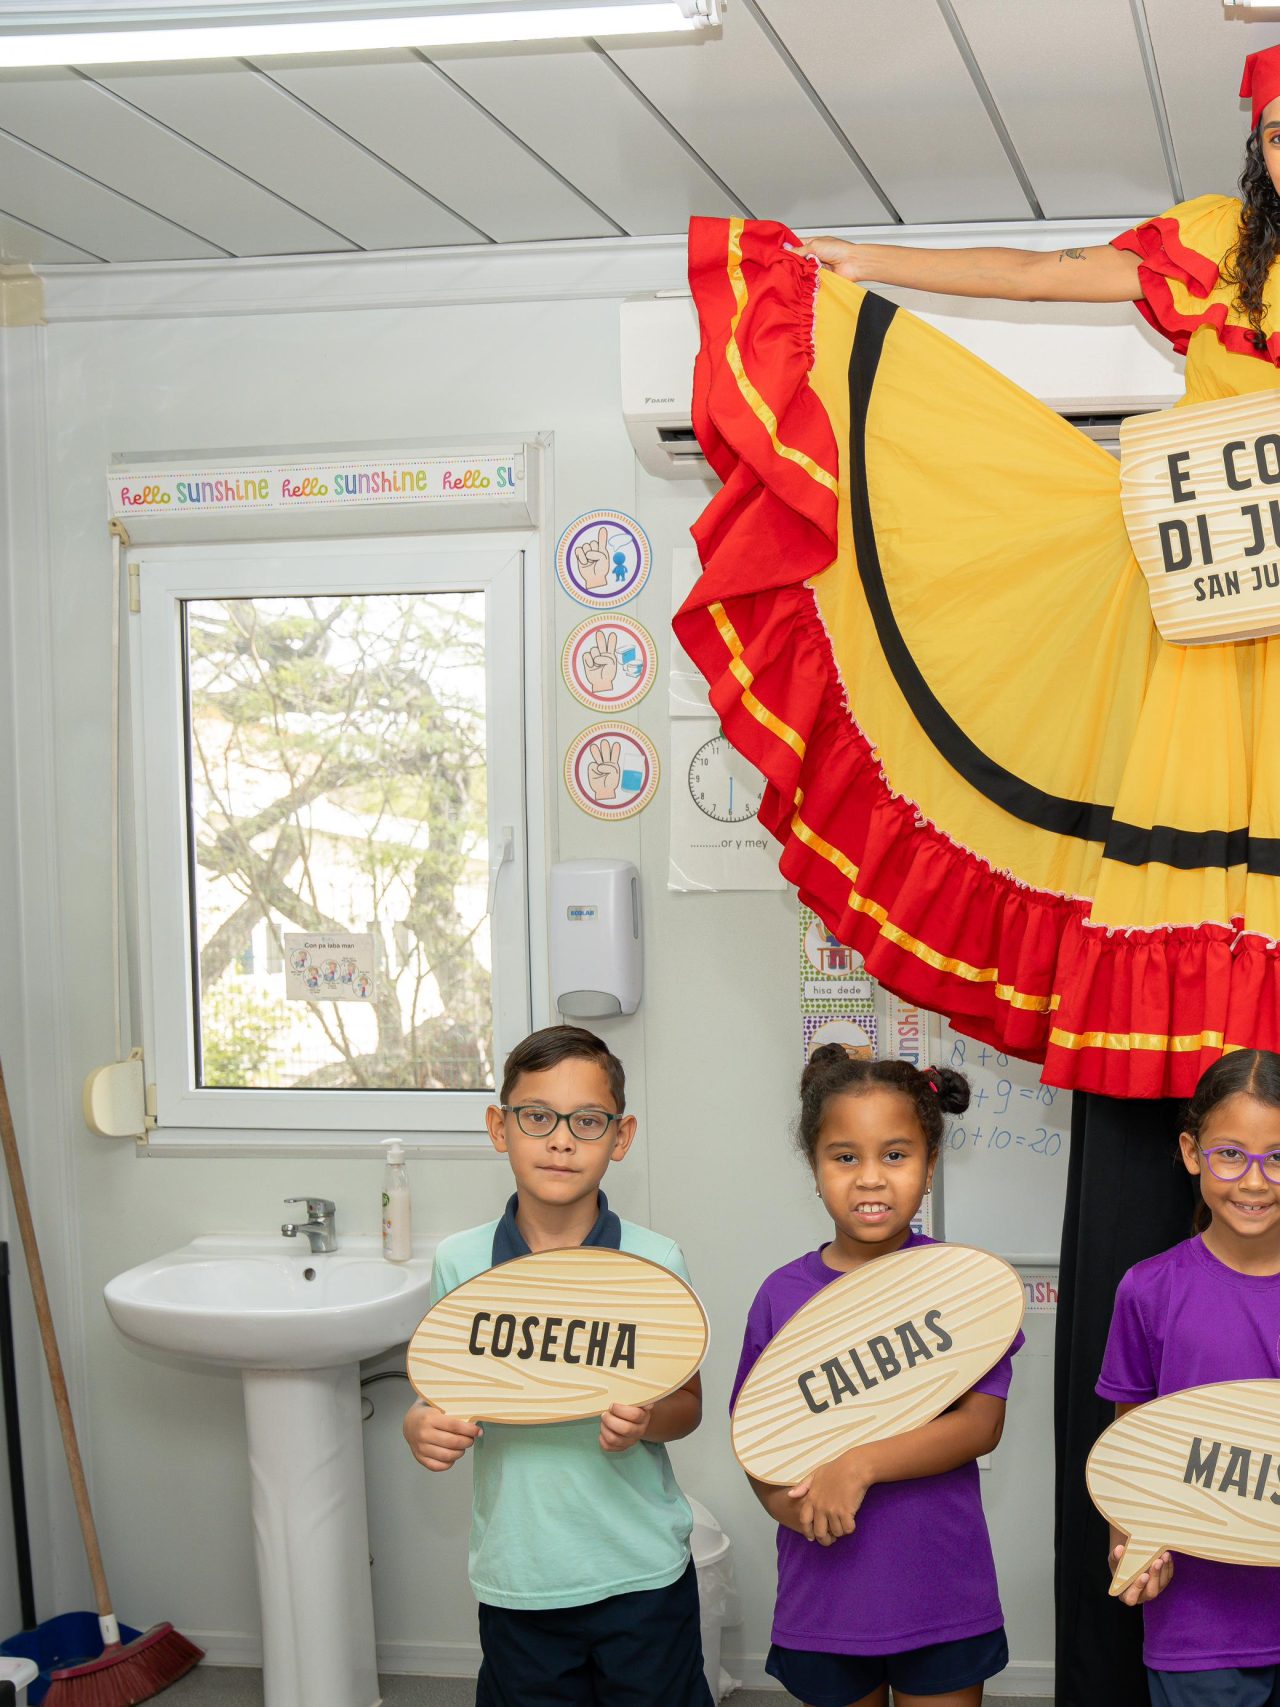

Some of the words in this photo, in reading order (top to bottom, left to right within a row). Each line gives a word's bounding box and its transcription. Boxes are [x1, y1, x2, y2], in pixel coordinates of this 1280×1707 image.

[121, 486, 171, 507] hello
[176, 479, 270, 504] sunshine
[281, 476, 329, 499] hello
[334, 469, 428, 496] sunshine
[442, 470, 490, 491] hello
[1167, 451, 1197, 503] E
[1158, 514, 1214, 574] DI
[1193, 568, 1242, 602] SAN
[745, 839, 769, 850] mey
[813, 985, 832, 995] hisa
[837, 985, 862, 995] dede
[468, 1311, 637, 1370] COSECHA
[796, 1309, 954, 1415] CALBAS
